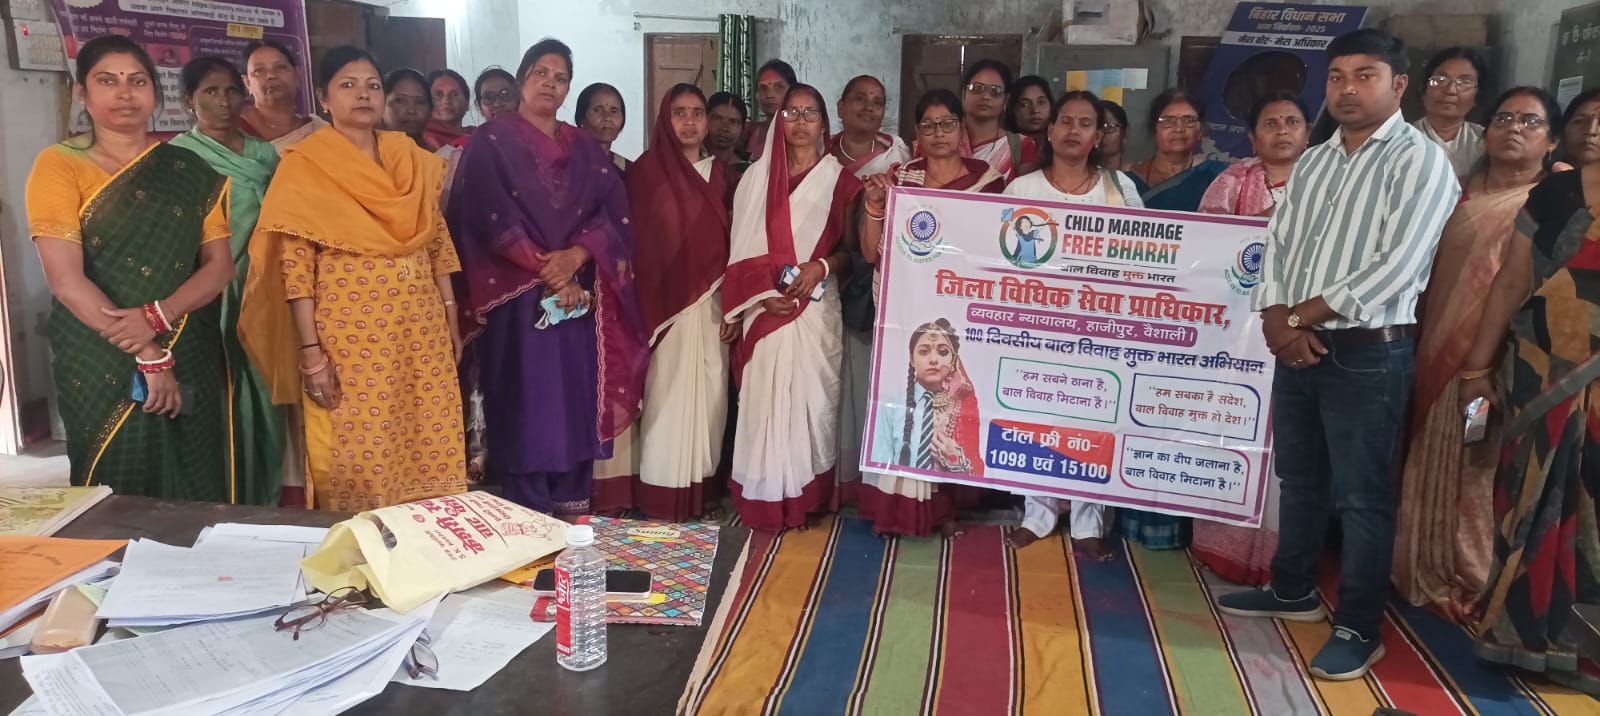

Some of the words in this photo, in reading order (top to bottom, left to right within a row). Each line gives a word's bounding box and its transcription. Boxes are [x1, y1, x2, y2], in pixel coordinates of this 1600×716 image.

[1249, 7, 1281, 20] बिहार
[1282, 8, 1314, 22] विधान
[1317, 12, 1346, 23] सभा
[1305, 25, 1326, 33] 2025
[1237, 34, 1254, 43] मेरा
[1274, 35, 1290, 46] मेरा
[1293, 36, 1327, 48] अधिकार
[1065, 214, 1104, 233] CHILD
[1107, 218, 1184, 241] MARRIAGE
[1061, 233, 1104, 257] FREE
[1106, 238, 1180, 265] BHARAT
[1085, 265, 1121, 279] विवाह
[1123, 269, 1145, 282] मुक्त
[1147, 272, 1176, 284] भारत
[935, 268, 995, 301] जिला
[999, 275, 1073, 309] विधिक
[1077, 284, 1123, 314] सेवा
[1128, 292, 1231, 329] प्राधिकार,
[970, 308, 1015, 323] व्यवहार
[1018, 314, 1082, 332] न्यायालय,
[1086, 319, 1138, 338] हाजीपुर,
[964, 328, 983, 343] 100
[986, 329, 1043, 349] दिवसीय
[1045, 336, 1076, 353] बाल
[1078, 338, 1121, 360] विवाह
[1123, 346, 1155, 368] मुक्त
[1158, 351, 1198, 367] भारत
[1199, 351, 1265, 373] अभियान
[1042, 373, 1068, 385] सबने
[1071, 377, 1094, 388] ठाना
[1002, 387, 1022, 398] बाल
[1026, 388, 1054, 402] विवाह
[1056, 390, 1091, 407] मिटाना
[1175, 390, 1204, 401] सबका
[1206, 390, 1214, 402] है
[1135, 404, 1155, 415] बाल
[1158, 403, 1185, 418] विवाह
[1188, 409, 1208, 422] मुक्त
[1211, 409, 1221, 422] हो
[1001, 426, 1035, 445] टॉल
[1039, 430, 1062, 448] फ्री
[990, 449, 1027, 469] 1098
[1032, 454, 1055, 473] एवं
[1060, 459, 1108, 480] 15100
[1157, 451, 1170, 463] का
[1174, 452, 1192, 465] दीप
[1195, 457, 1230, 472] जलाना
[1125, 466, 1145, 478] बाल
[1149, 467, 1176, 483] विवाह
[1180, 471, 1215, 488] मिटाना
